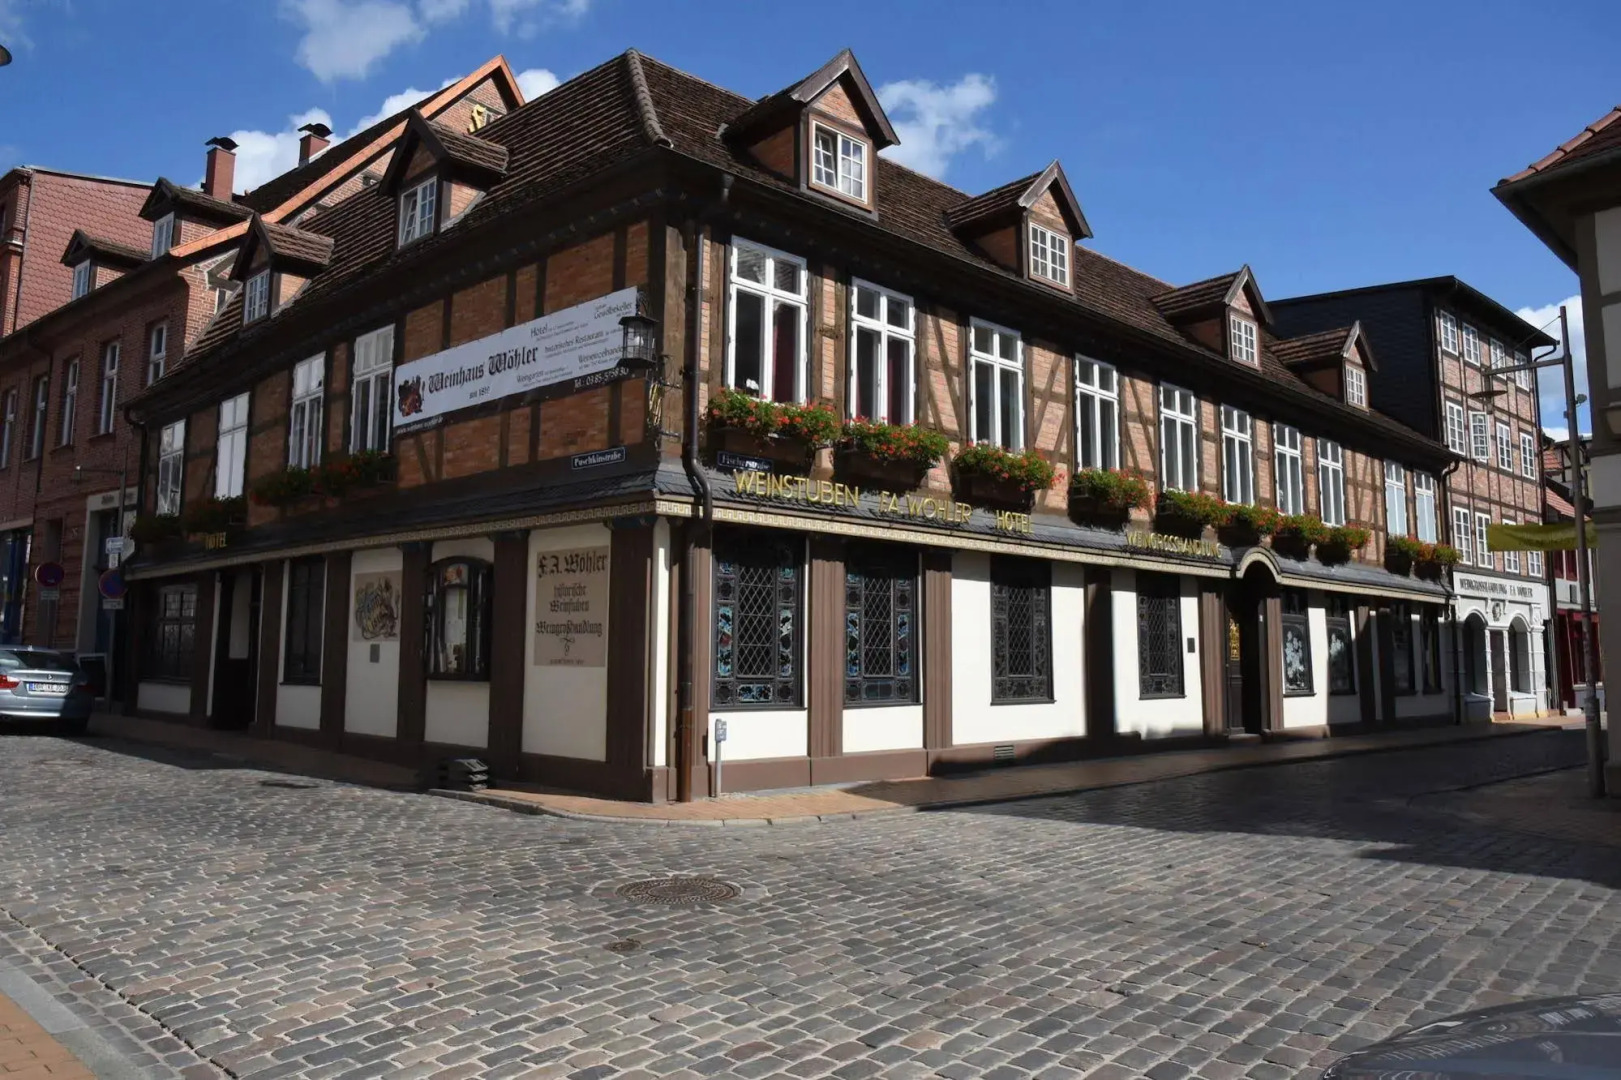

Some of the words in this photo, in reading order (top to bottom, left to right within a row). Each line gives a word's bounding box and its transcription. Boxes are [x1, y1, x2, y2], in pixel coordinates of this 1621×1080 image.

[530, 322, 548, 338] Hotel
[428, 362, 485, 395] Weinhaus
[488, 346, 538, 377] Wöhler
[574, 450, 622, 467] Puschkinstraße
[733, 468, 859, 508] WEINSTUBEN
[905, 494, 973, 525] WÖHLER
[996, 509, 1034, 534] HOTEL
[1124, 528, 1223, 558] WEINGROSSHANDLUNG
[564, 551, 608, 574] Wöhler
